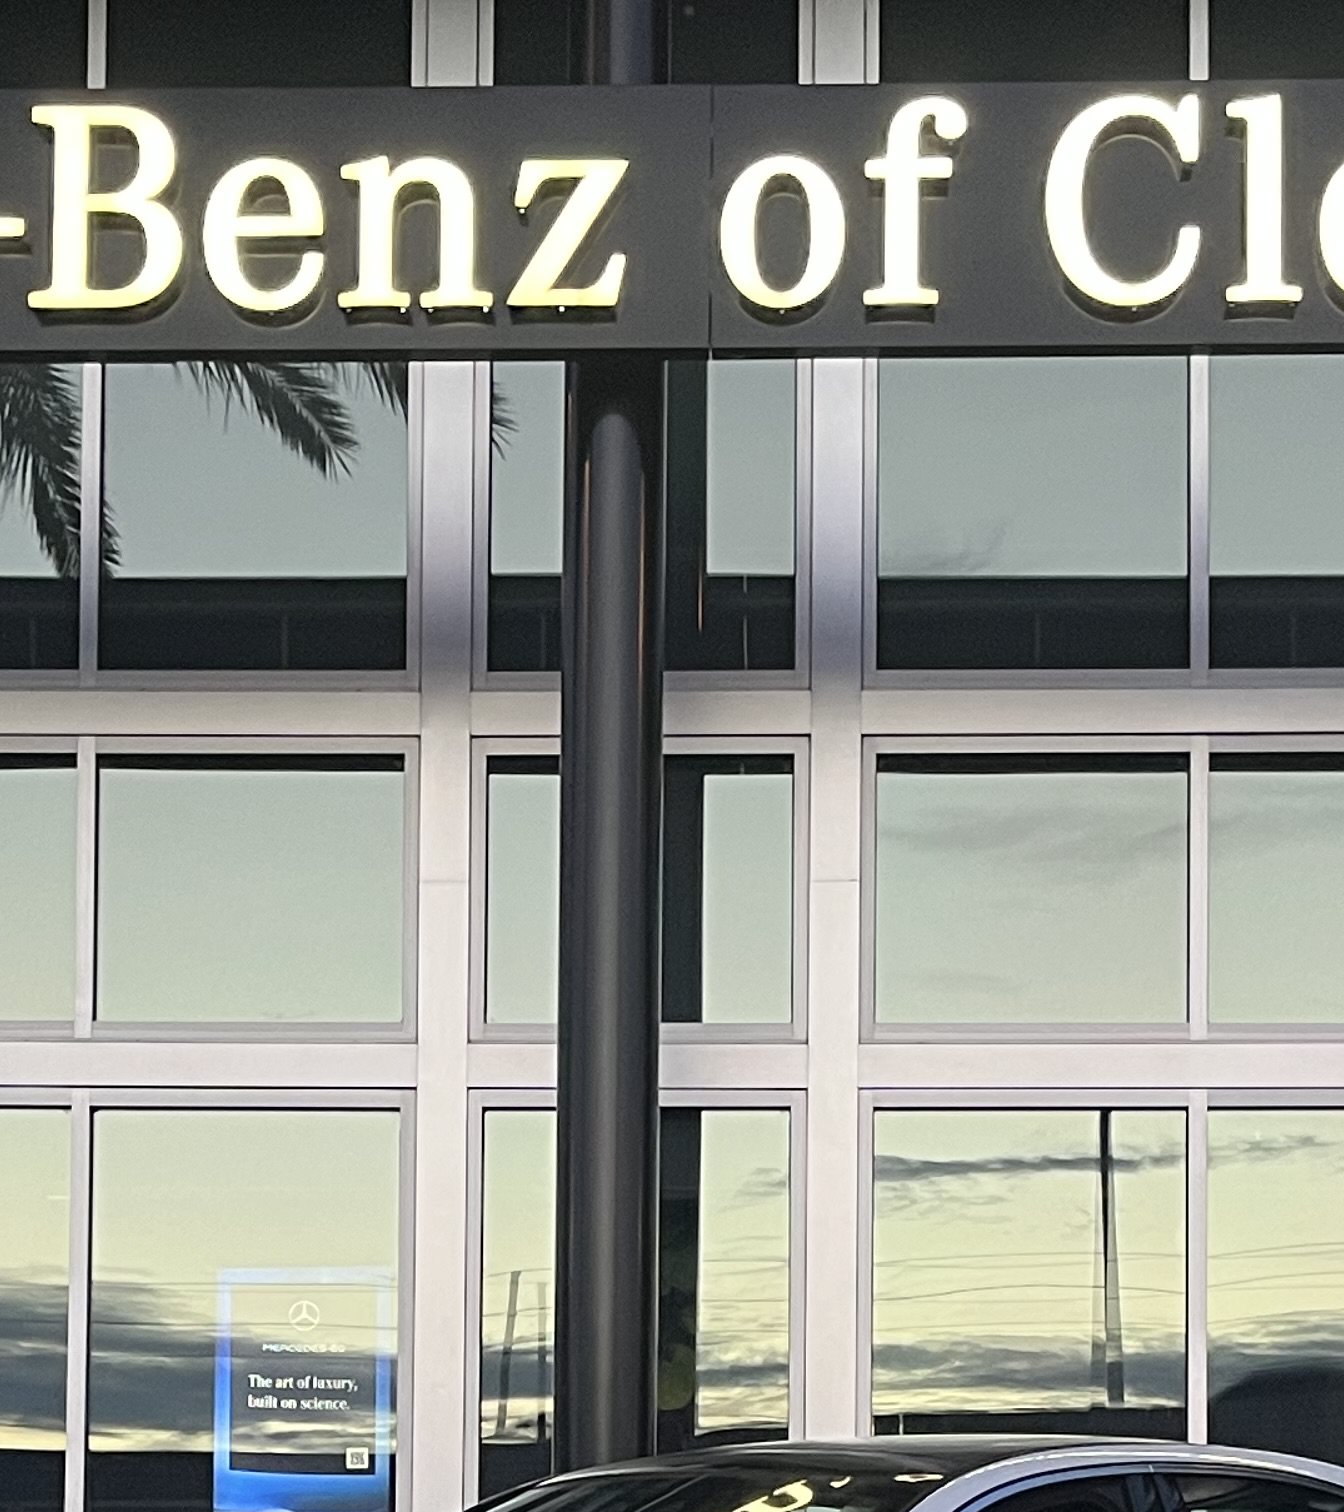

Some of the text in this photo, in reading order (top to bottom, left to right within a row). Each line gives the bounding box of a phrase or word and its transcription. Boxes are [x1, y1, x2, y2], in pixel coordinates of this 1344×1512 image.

[719, 95, 969, 309] of
[247, 1373, 359, 1393] The art of luxury,
[247, 1394, 351, 1410] built on science.
